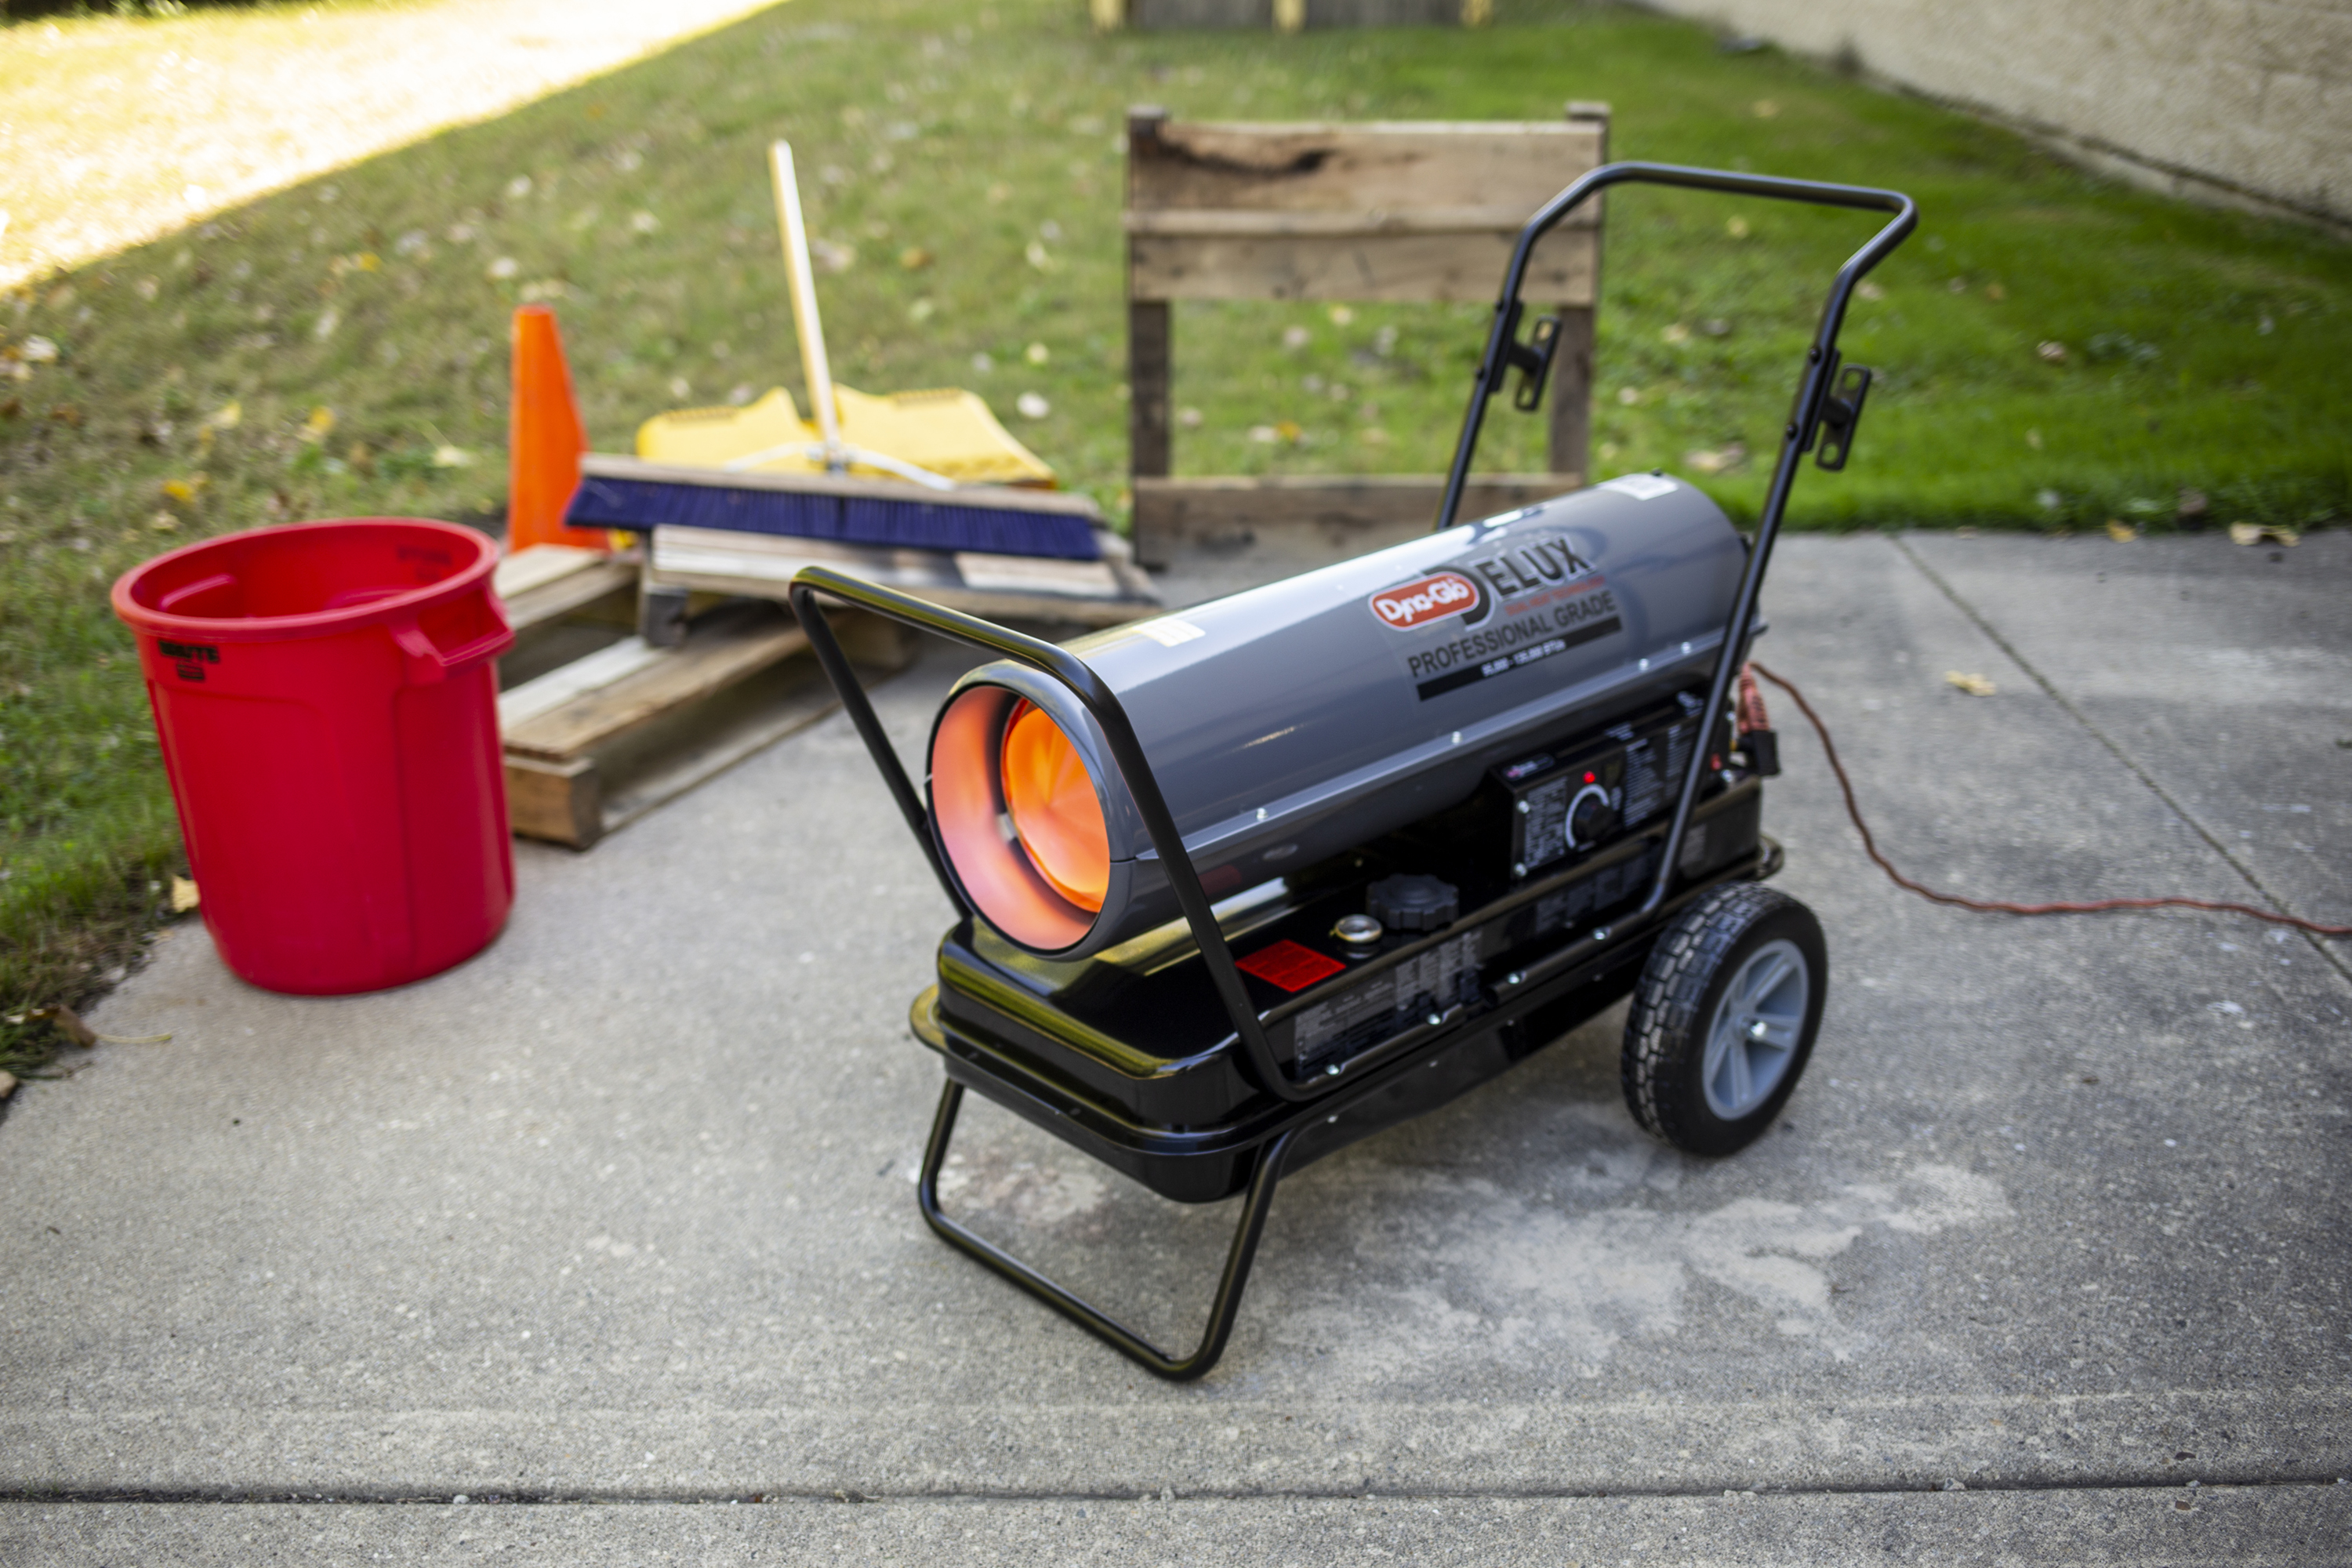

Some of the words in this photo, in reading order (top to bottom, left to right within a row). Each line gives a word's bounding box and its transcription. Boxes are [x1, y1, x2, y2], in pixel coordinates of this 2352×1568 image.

[1375, 575, 1471, 622] Dyna-Glo
[1409, 617, 1553, 677] PROFESSIONAL
[1553, 590, 1617, 628] GRADE
